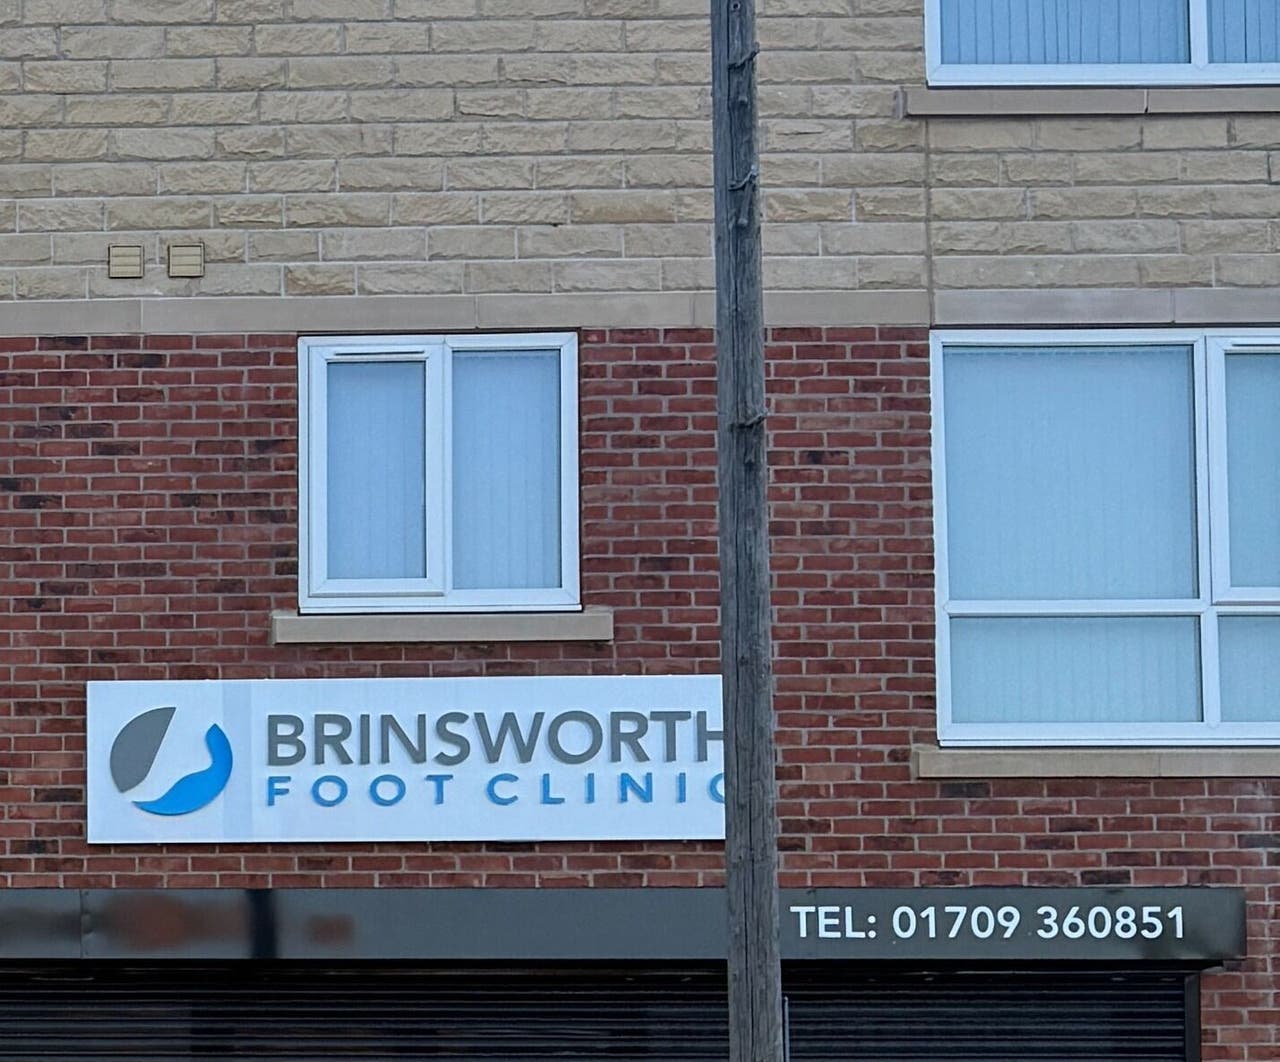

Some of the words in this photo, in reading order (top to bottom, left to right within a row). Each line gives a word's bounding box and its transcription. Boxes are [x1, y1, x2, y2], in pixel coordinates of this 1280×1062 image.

[268, 710, 724, 767] BRINSWORTH
[267, 773, 454, 807] FOOT
[790, 906, 878, 938] TEL:
[892, 906, 1022, 939] 01709
[1037, 906, 1185, 938] 360851
